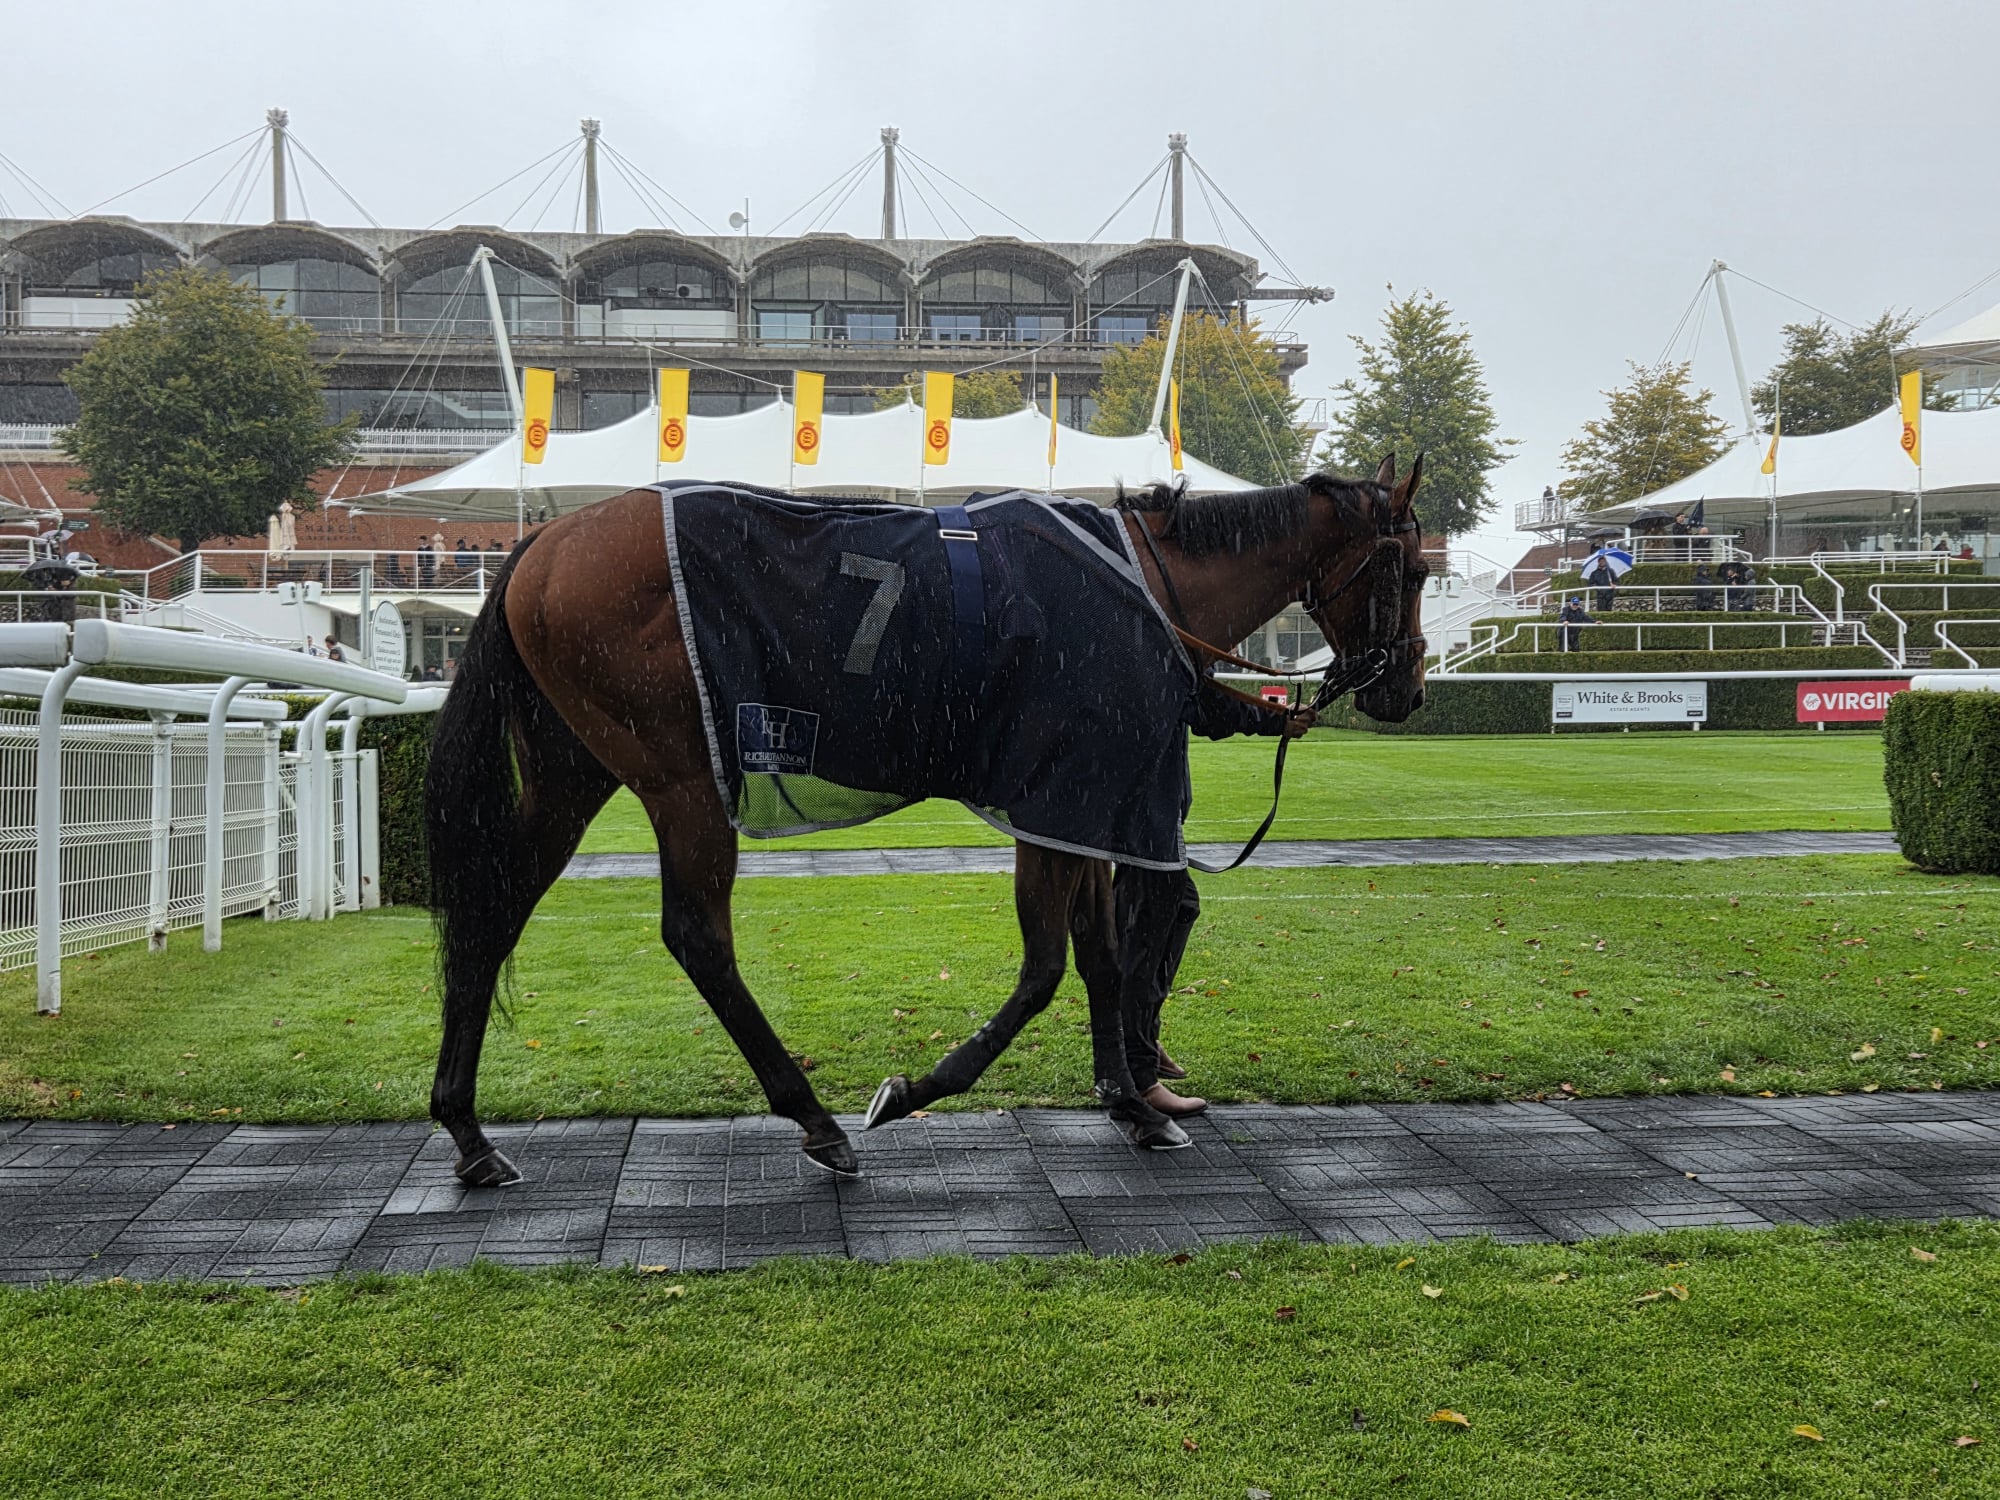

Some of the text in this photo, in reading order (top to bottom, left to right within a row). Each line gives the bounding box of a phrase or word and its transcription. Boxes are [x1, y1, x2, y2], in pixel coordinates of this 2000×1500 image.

[840, 551, 906, 675] 7
[1577, 690, 1683, 704] White & Brooks
